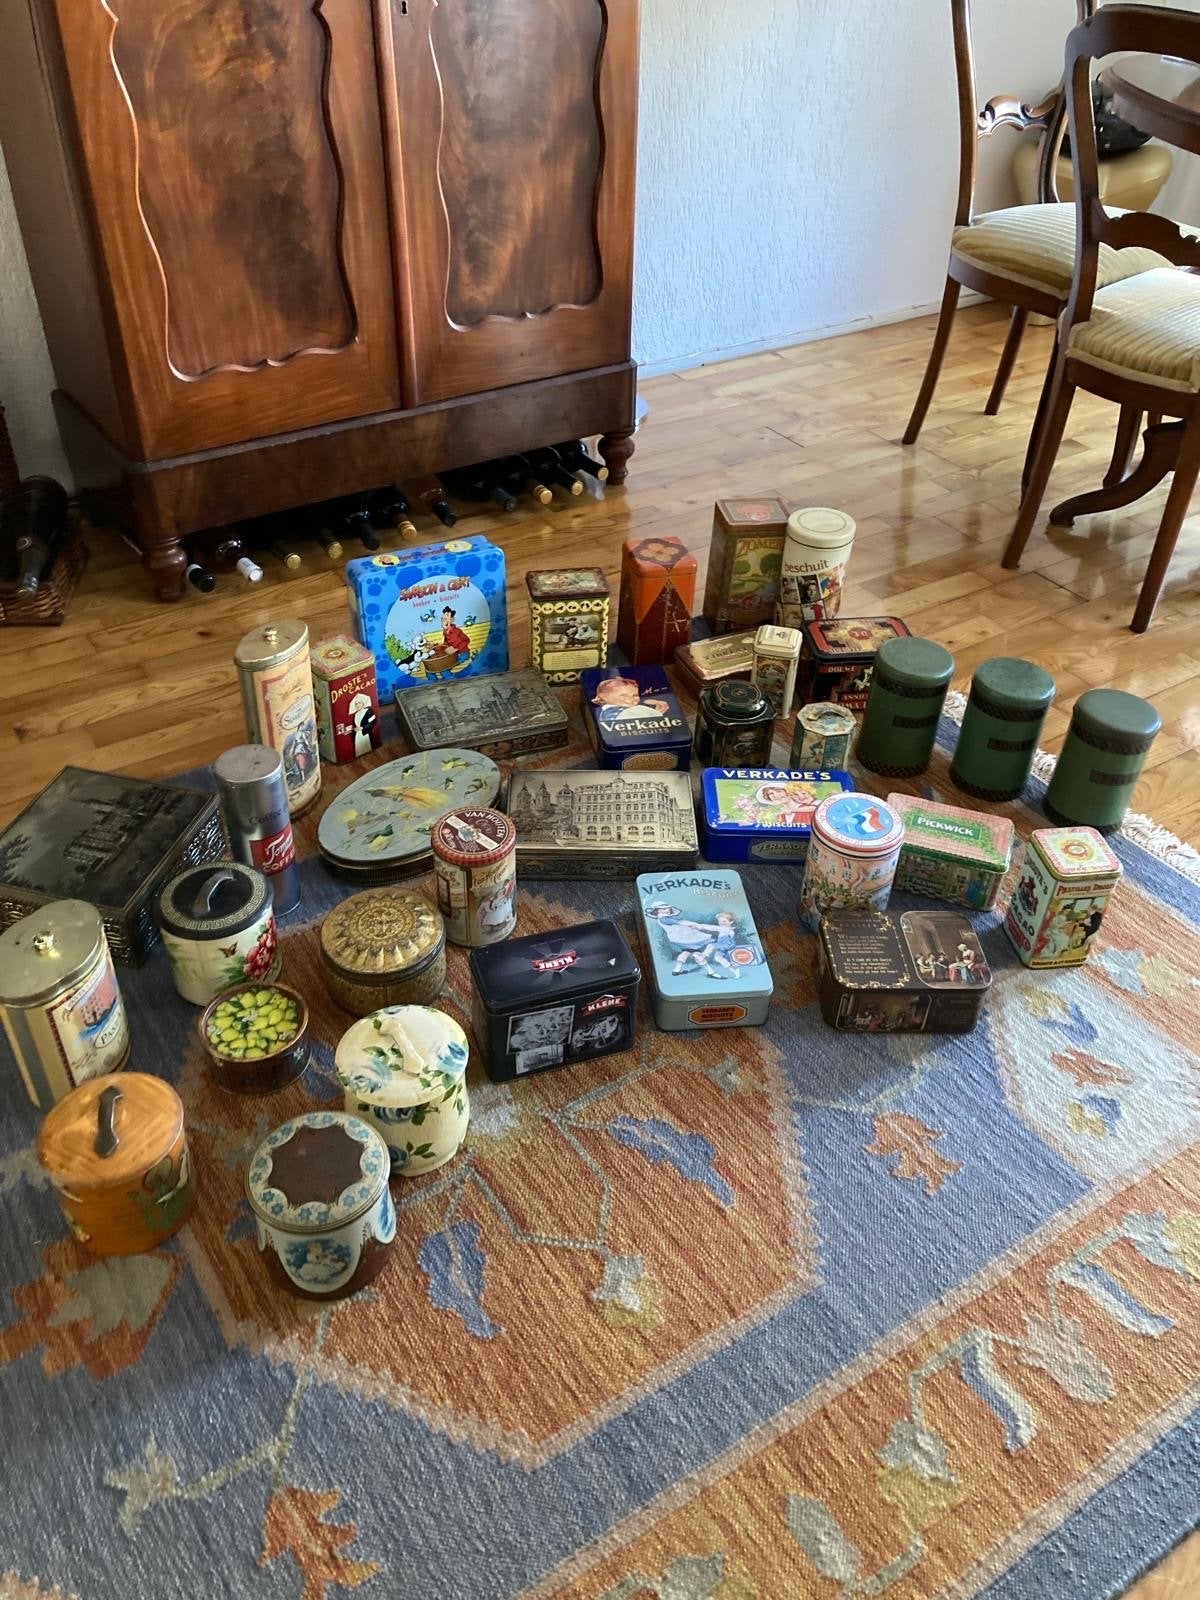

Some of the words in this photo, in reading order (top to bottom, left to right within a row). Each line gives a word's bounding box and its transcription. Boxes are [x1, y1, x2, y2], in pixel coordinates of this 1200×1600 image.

[784, 560, 830, 574] beschuit
[349, 678, 376, 694] CACAO
[600, 717, 683, 732] Verkade
[620, 728, 670, 737] BISCUITS
[722, 769, 832, 781] VERKADE'S
[485, 813, 506, 839] HOUTEN
[917, 816, 974, 836] PICKWICK
[539, 956, 574, 970] KLENE
[587, 998, 622, 1012] KLENE
